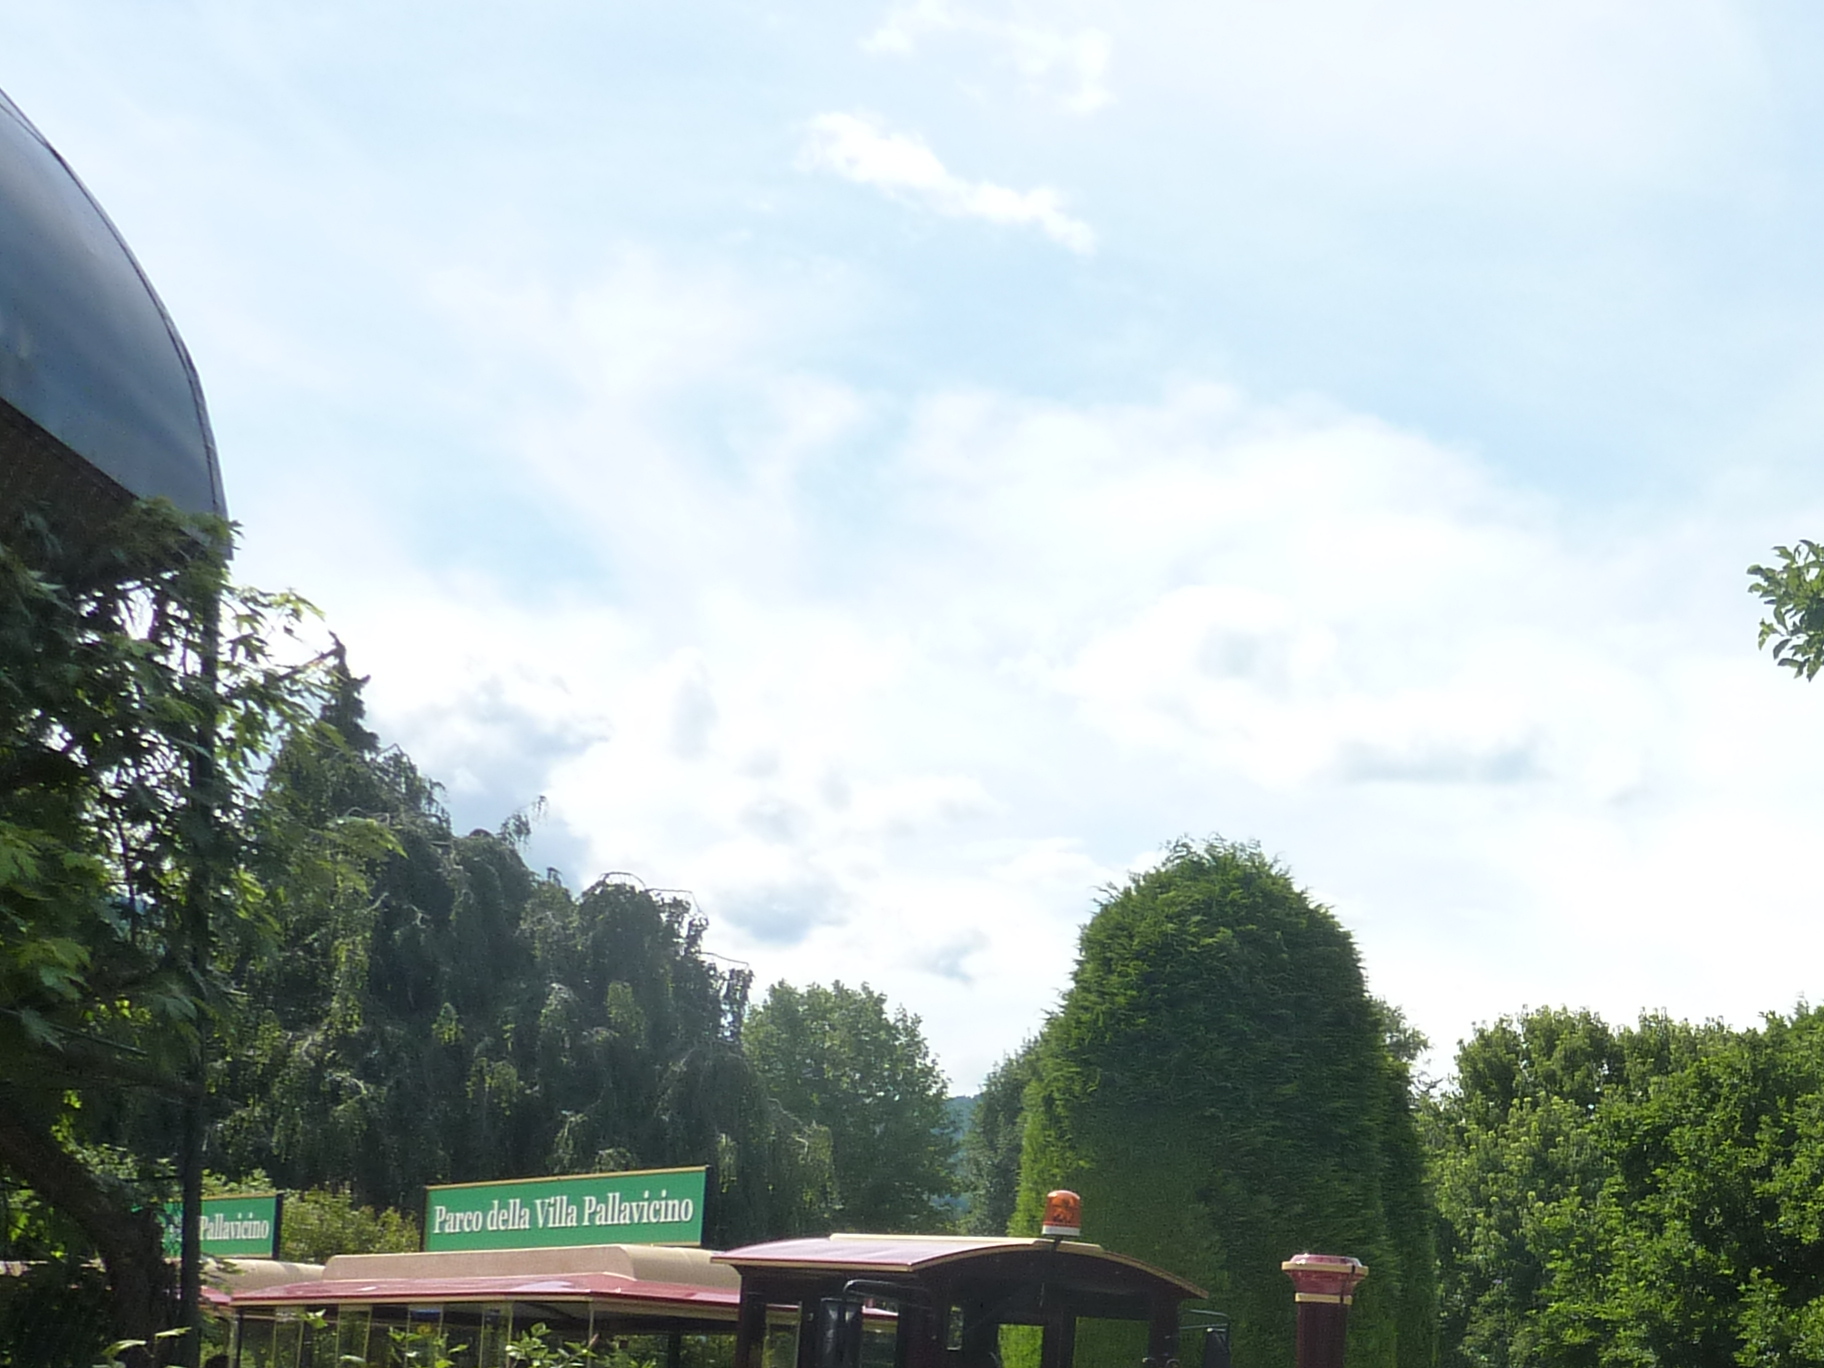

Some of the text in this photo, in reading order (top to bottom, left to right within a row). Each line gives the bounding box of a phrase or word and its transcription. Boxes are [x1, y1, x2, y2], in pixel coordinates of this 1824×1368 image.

[199, 1212, 269, 1241] Pallavicino
[433, 1188, 694, 1234] Parco della Villa Pallavicino
